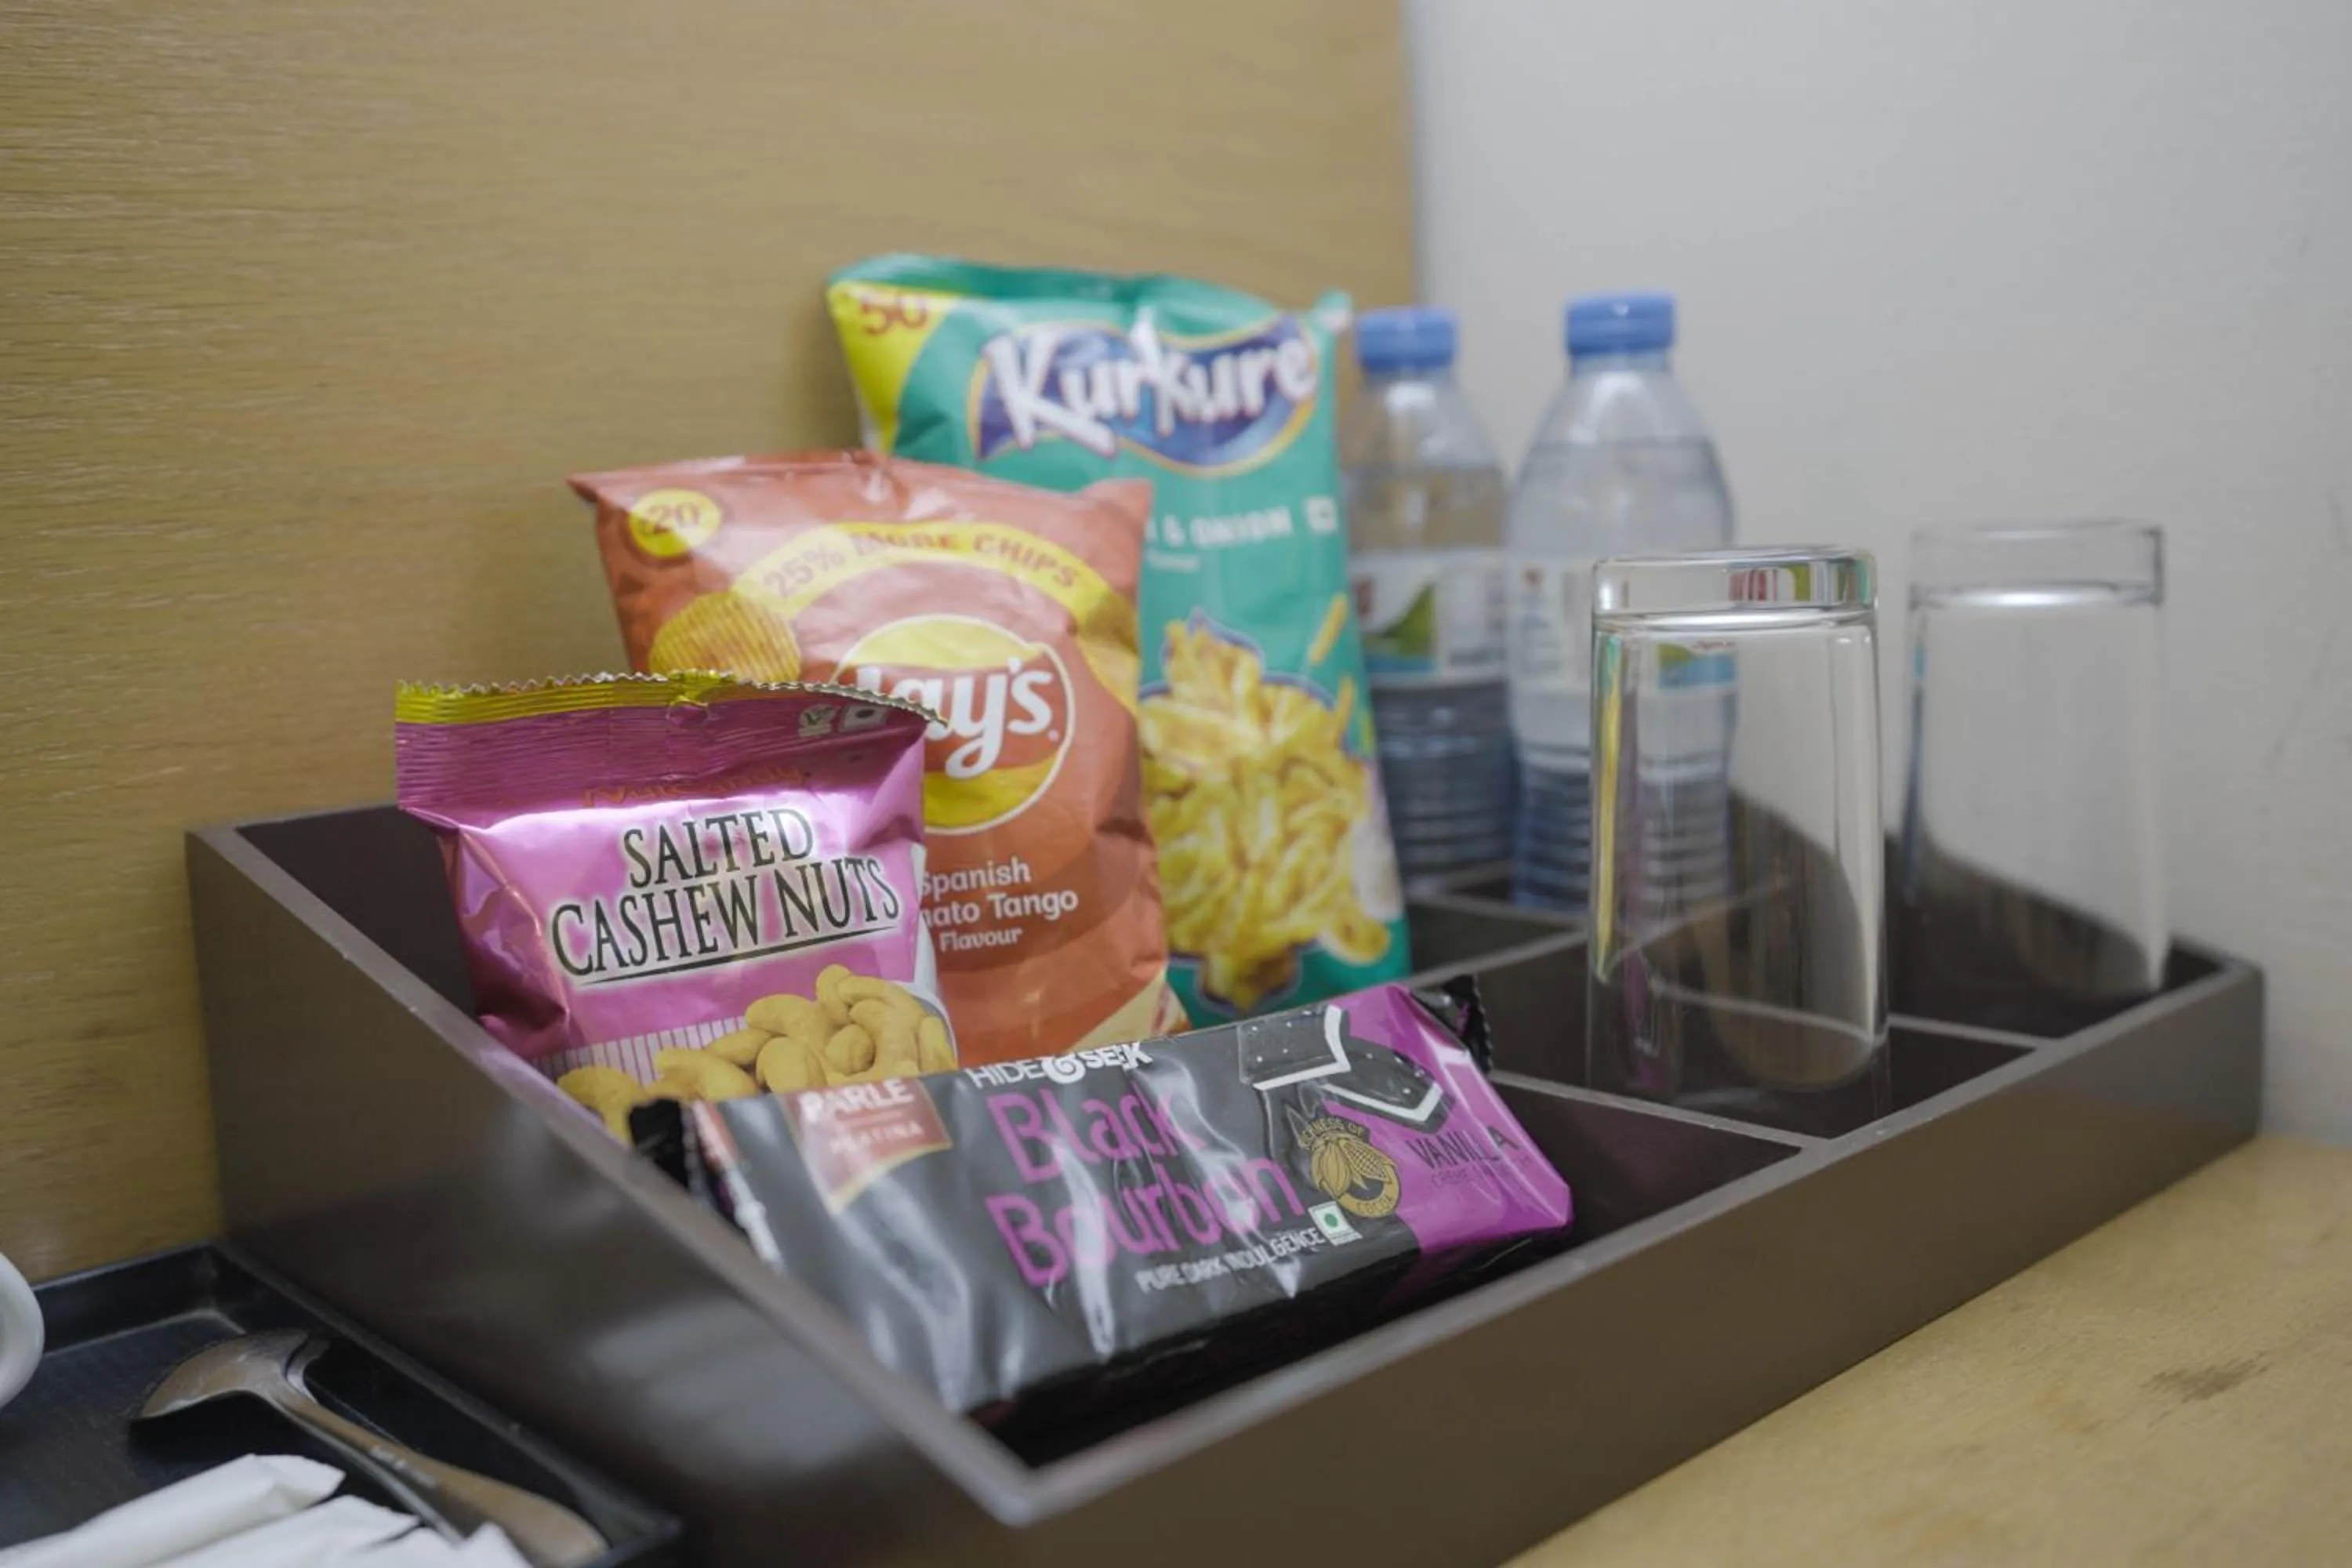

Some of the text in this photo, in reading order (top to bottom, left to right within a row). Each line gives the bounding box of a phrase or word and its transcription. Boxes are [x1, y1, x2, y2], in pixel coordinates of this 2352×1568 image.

[985, 307, 1319, 457] Kurkure
[763, 540, 846, 598] 25%
[973, 532, 1080, 588] CHIPS
[623, 808, 814, 889] SALTED
[553, 857, 900, 975] CASHEW NUTS
[985, 889, 1079, 920] Tango
[939, 927, 1023, 953] Flavour
[797, 1076, 916, 1123] PARLE
[964, 1058, 1046, 1089] HIDE
[987, 1080, 1207, 1183] Black
[985, 1158, 1305, 1287] Bourbon
[1134, 1264, 1185, 1294] PURE
[1179, 1257, 1230, 1284] DARK
